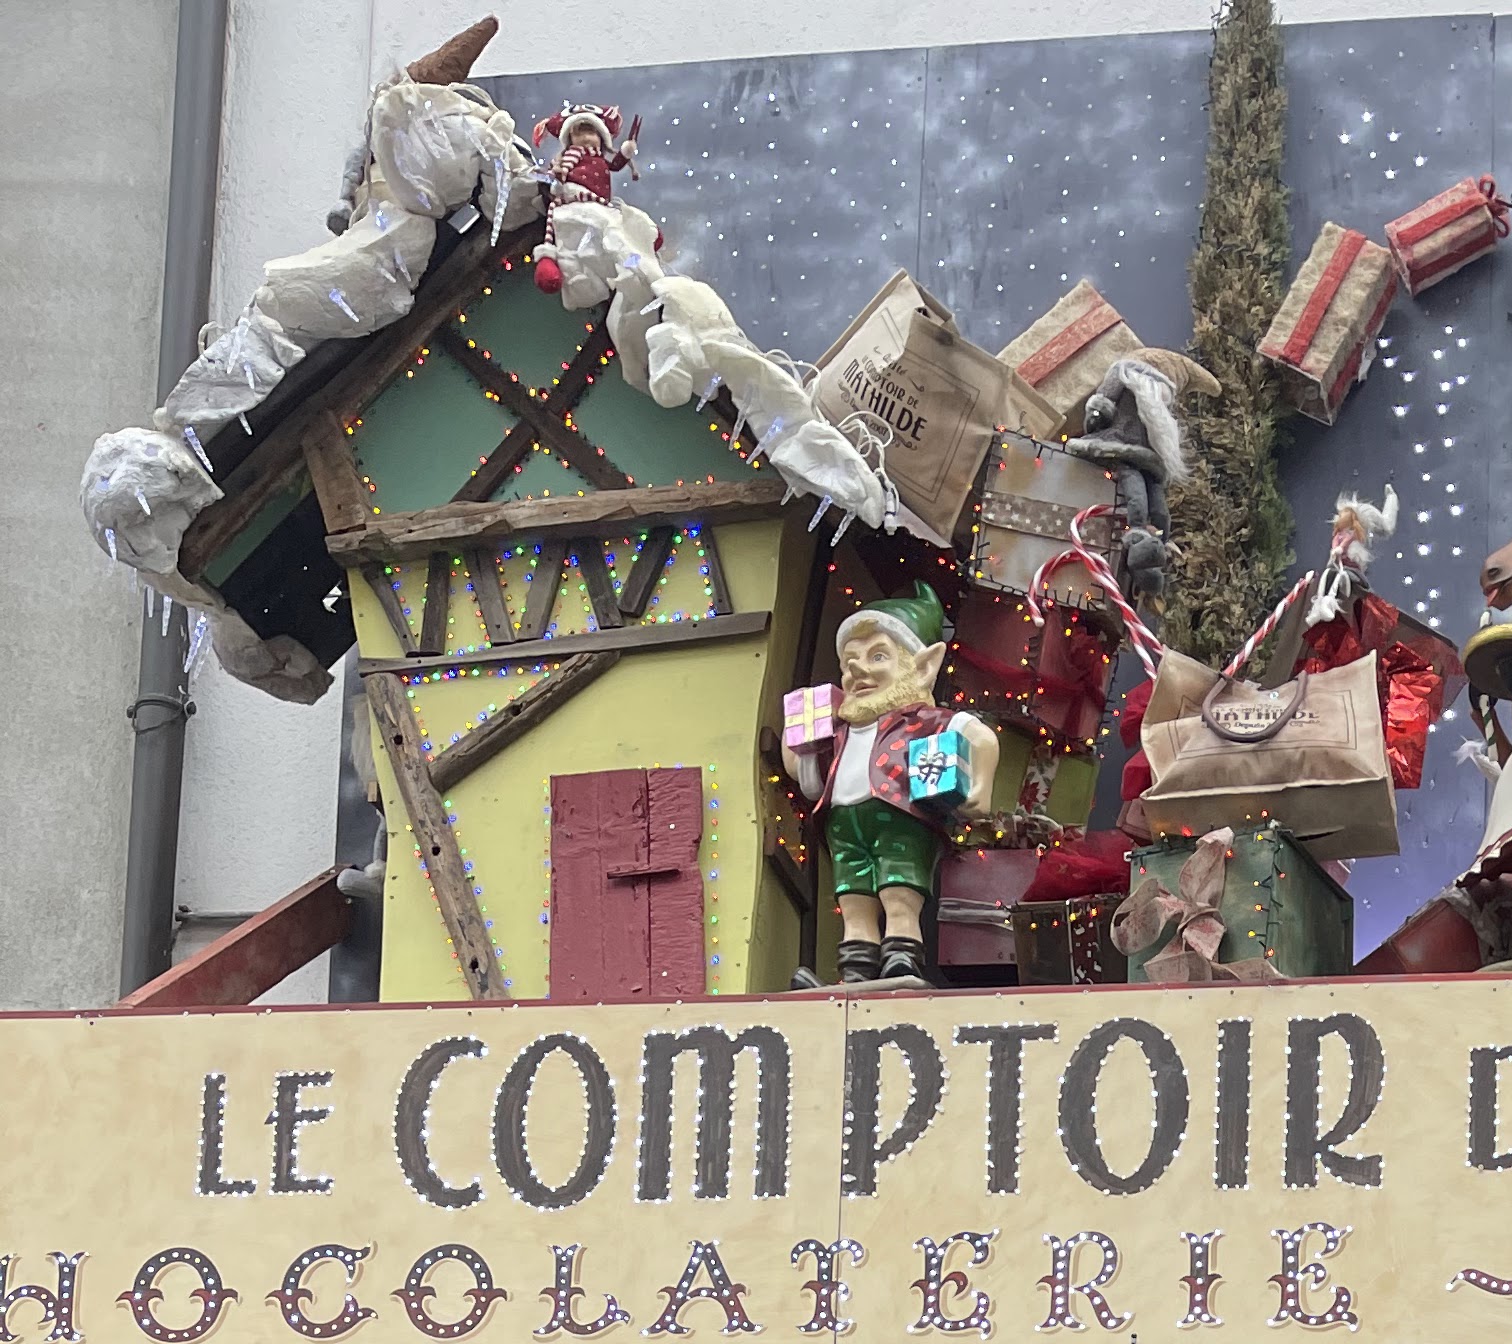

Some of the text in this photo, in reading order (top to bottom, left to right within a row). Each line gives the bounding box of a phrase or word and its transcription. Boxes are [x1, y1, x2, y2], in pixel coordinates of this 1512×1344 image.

[843, 358, 928, 442] MATHILDE
[195, 1071, 336, 1197] LE
[393, 1012, 1386, 1211] COMPTOIR
